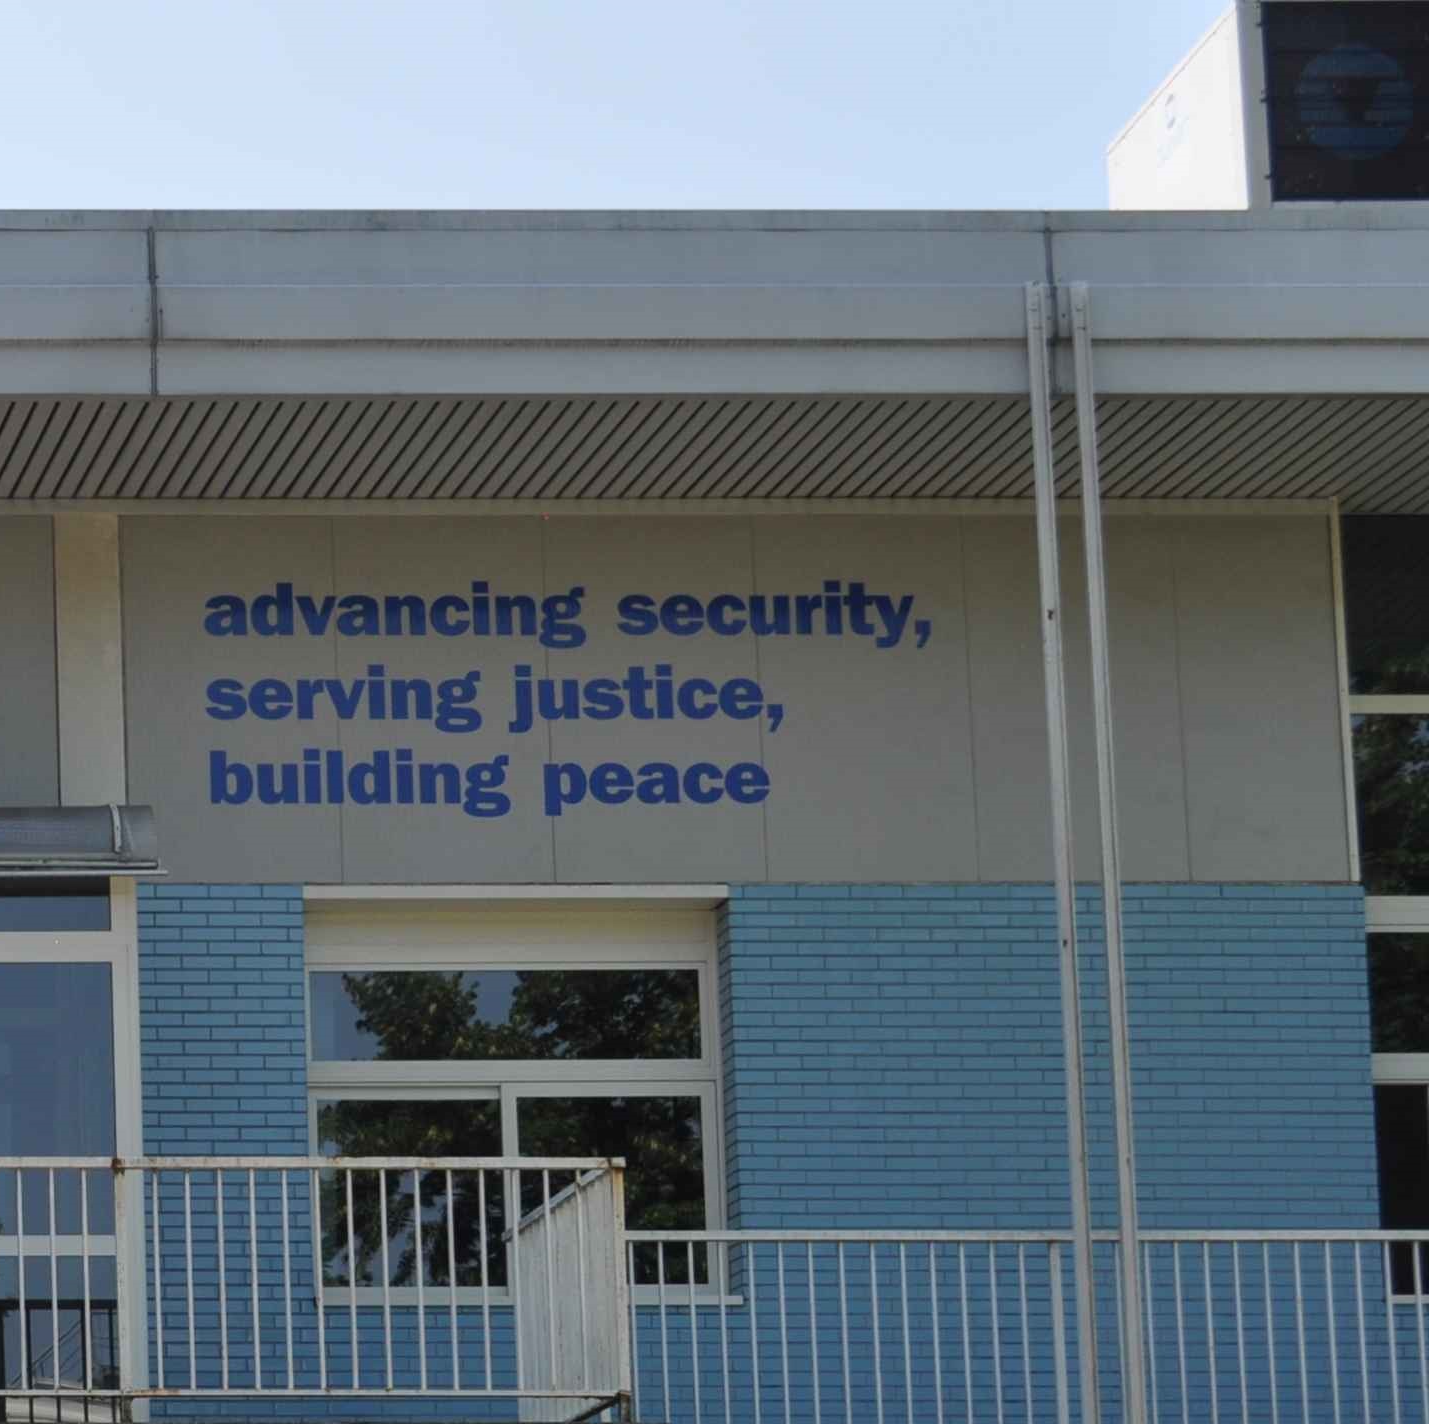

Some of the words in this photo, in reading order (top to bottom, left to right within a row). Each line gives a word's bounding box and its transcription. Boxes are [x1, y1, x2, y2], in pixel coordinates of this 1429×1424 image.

[204, 582, 586, 648] advancing
[617, 582, 932, 648] security,
[205, 664, 483, 733] serving
[508, 664, 785, 733] justice,
[208, 747, 512, 818] building
[543, 760, 770, 817] peace
